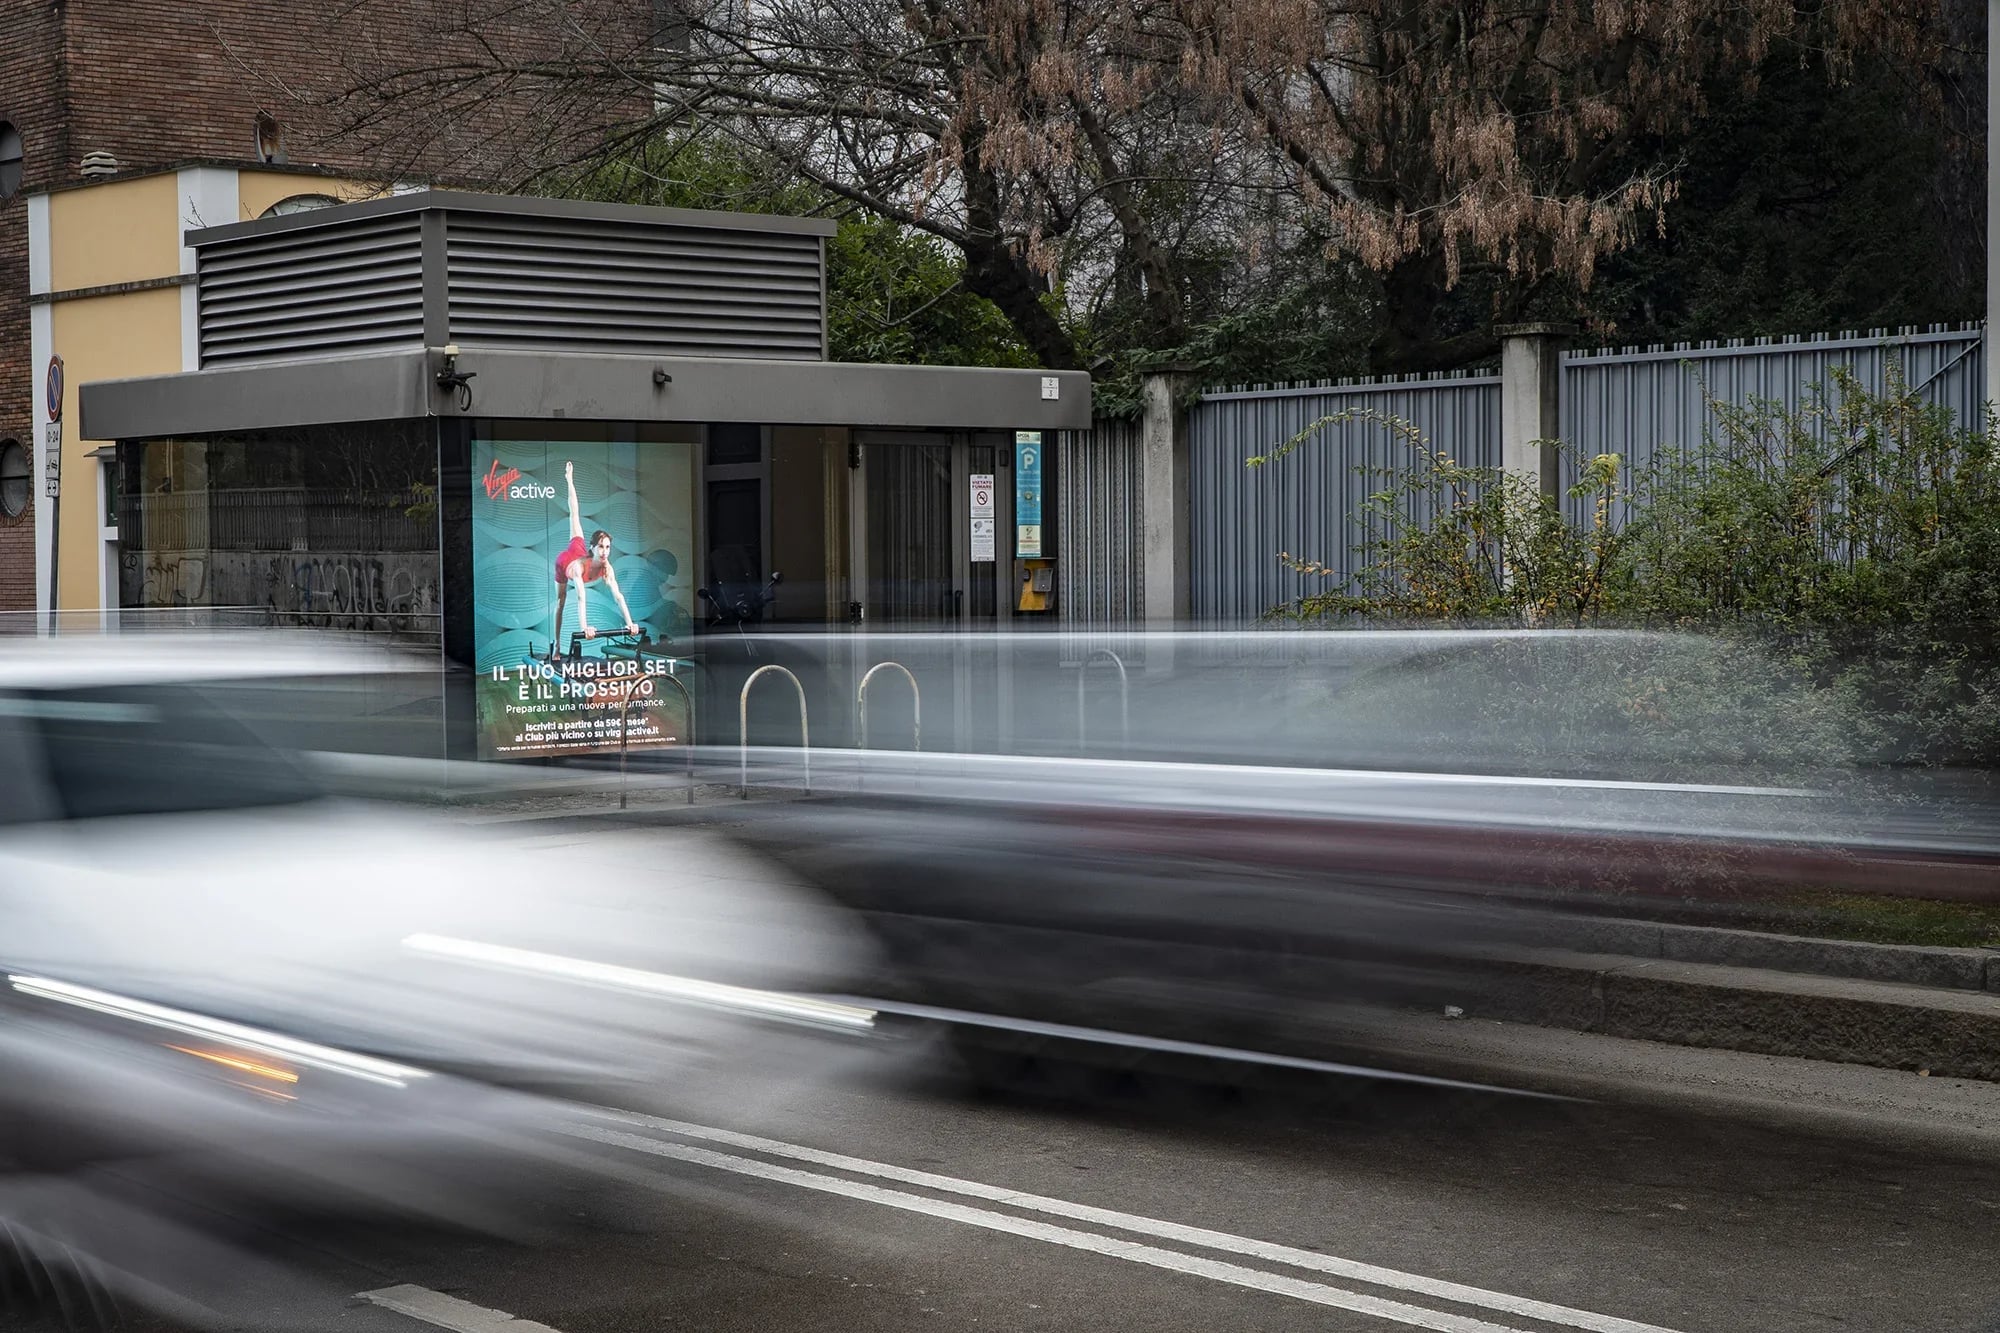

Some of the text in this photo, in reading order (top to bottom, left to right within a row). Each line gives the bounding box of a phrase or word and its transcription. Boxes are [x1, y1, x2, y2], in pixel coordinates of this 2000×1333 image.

[482, 459, 521, 502] Virgin
[510, 483, 555, 499] active
[493, 659, 677, 681] IL TUO MIGLIOR SET
[519, 681, 530, 700] È
[537, 684, 553, 699] IL
[506, 703, 548, 714] Preparati
[578, 702, 606, 710] nuova
[526, 721, 556, 731] Iscriviti
[564, 720, 592, 730] partire
[593, 719, 604, 728] da
[515, 733, 523, 742] al
[525, 732, 544, 741] Club
[545, 731, 559, 742] più
[561, 730, 586, 740] vicino
[594, 730, 604, 738] su
